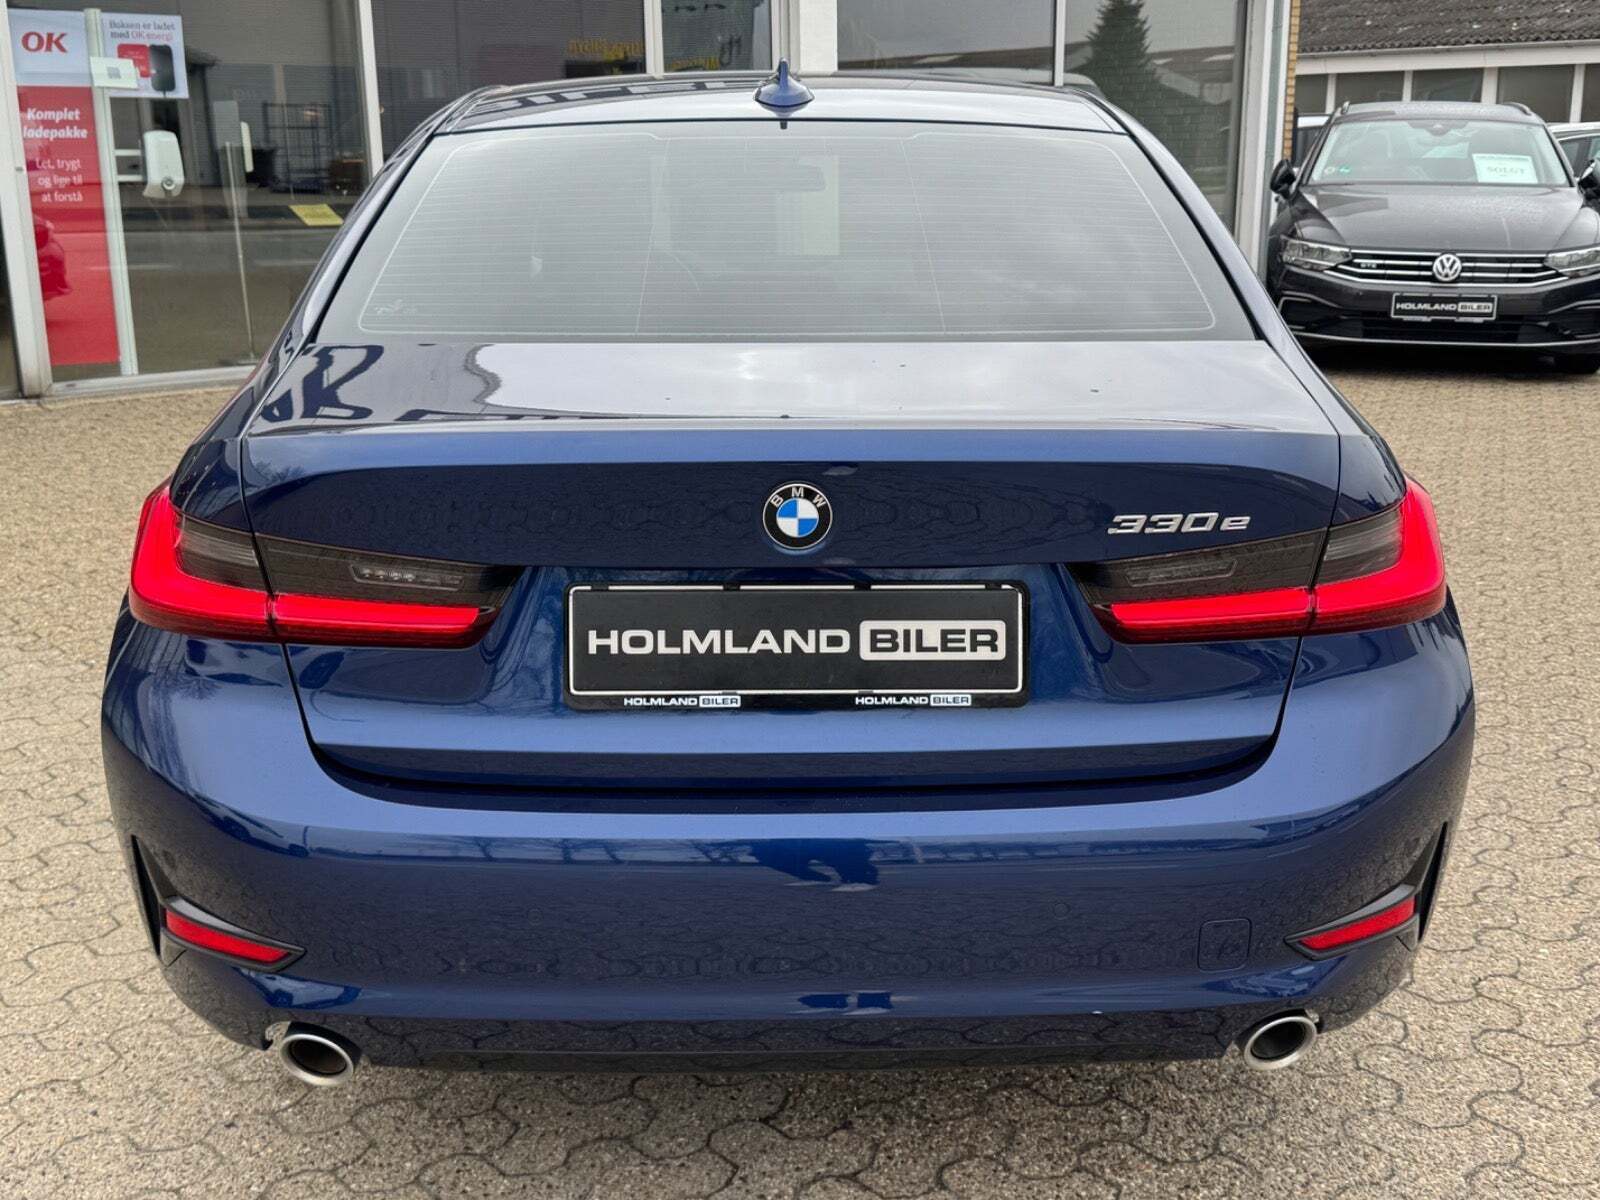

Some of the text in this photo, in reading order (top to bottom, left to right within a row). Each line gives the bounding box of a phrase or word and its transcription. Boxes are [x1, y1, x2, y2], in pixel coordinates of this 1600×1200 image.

[21, 31, 68, 53] OK
[27, 107, 80, 123] Komplet
[23, 125, 88, 141] ladepakke
[56, 158, 81, 171] trygt
[38, 177, 51, 188] og
[42, 190, 83, 202] at forstå
[770, 487, 826, 507] BMW
[1107, 512, 1251, 534] 330e
[588, 628, 999, 655] HOLMLAND BILER
[624, 697, 738, 706] HOLMLAND BILER
[855, 696, 969, 705] HOLMLAND BILER
